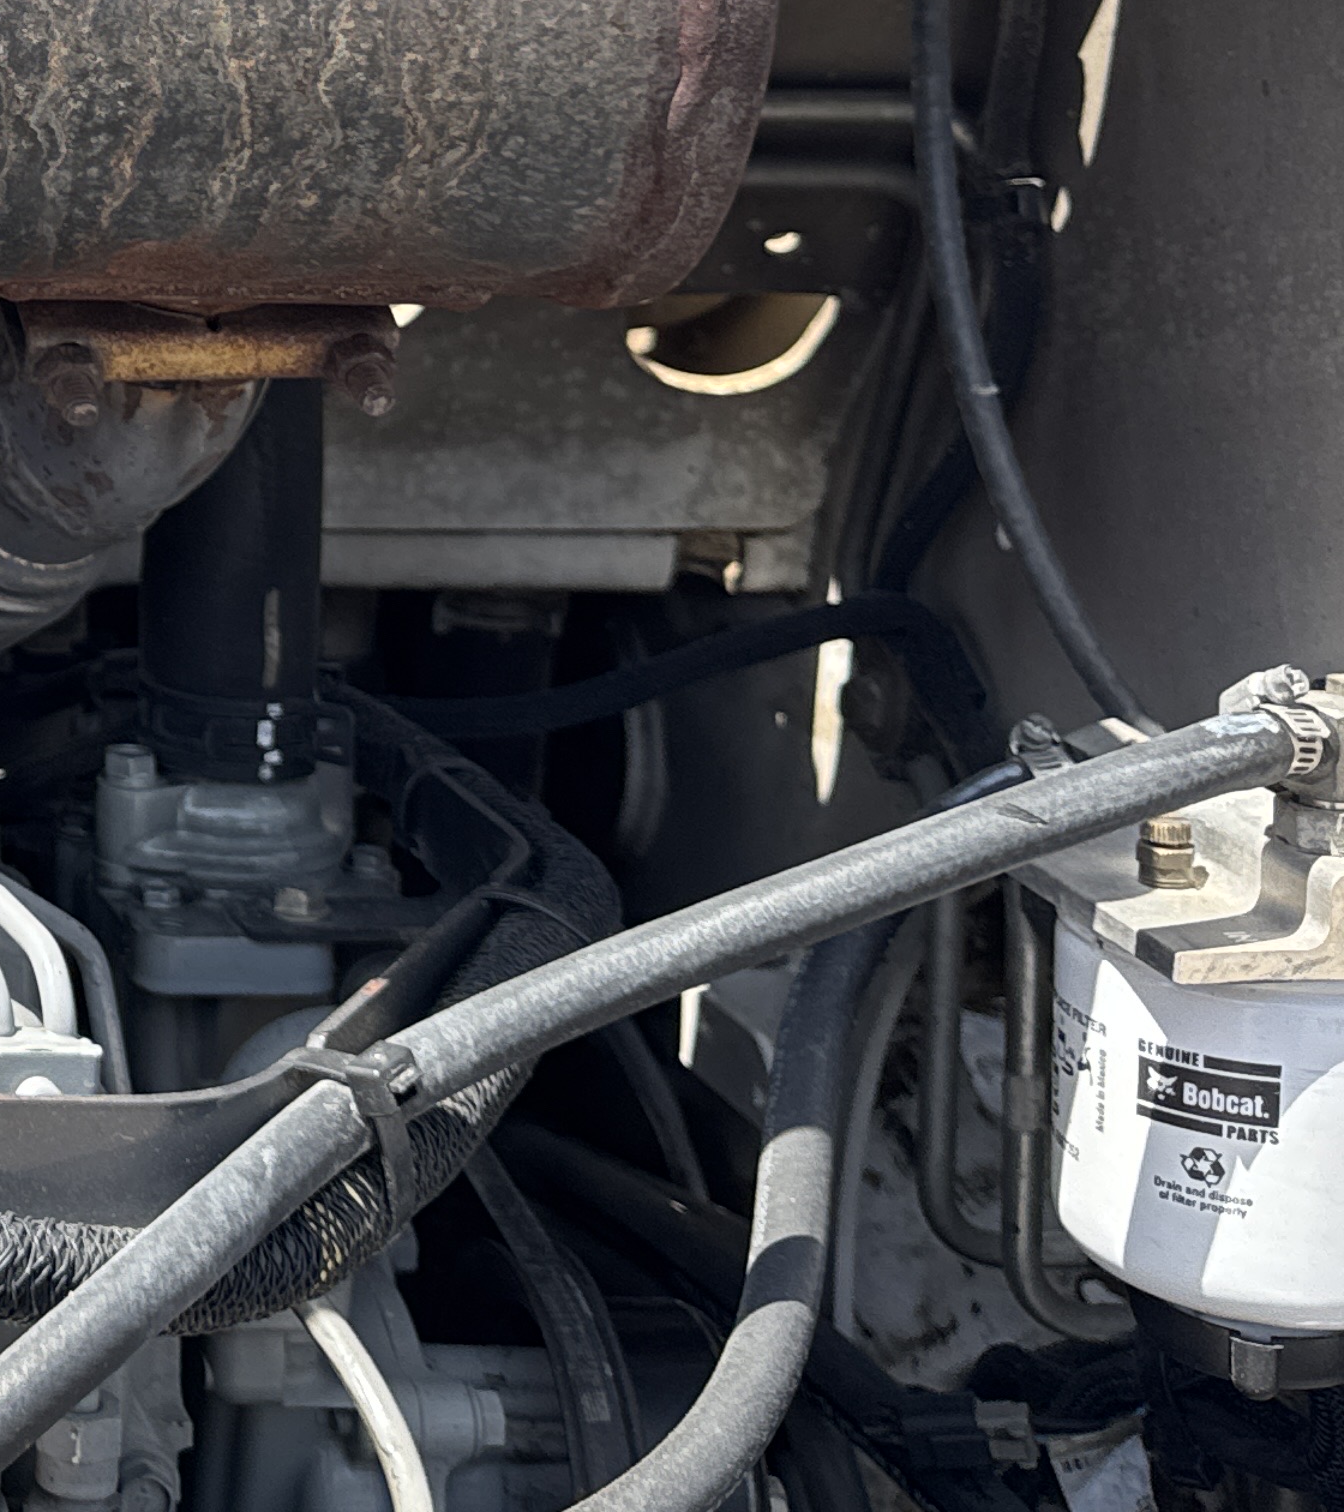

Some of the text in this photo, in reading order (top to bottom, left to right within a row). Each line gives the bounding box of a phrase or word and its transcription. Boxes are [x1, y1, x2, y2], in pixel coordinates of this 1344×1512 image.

[1138, 1038, 1200, 1067] GENUINE
[1226, 1125, 1279, 1145] PARTS
[1154, 1175, 1253, 1207] Drain and dispose
